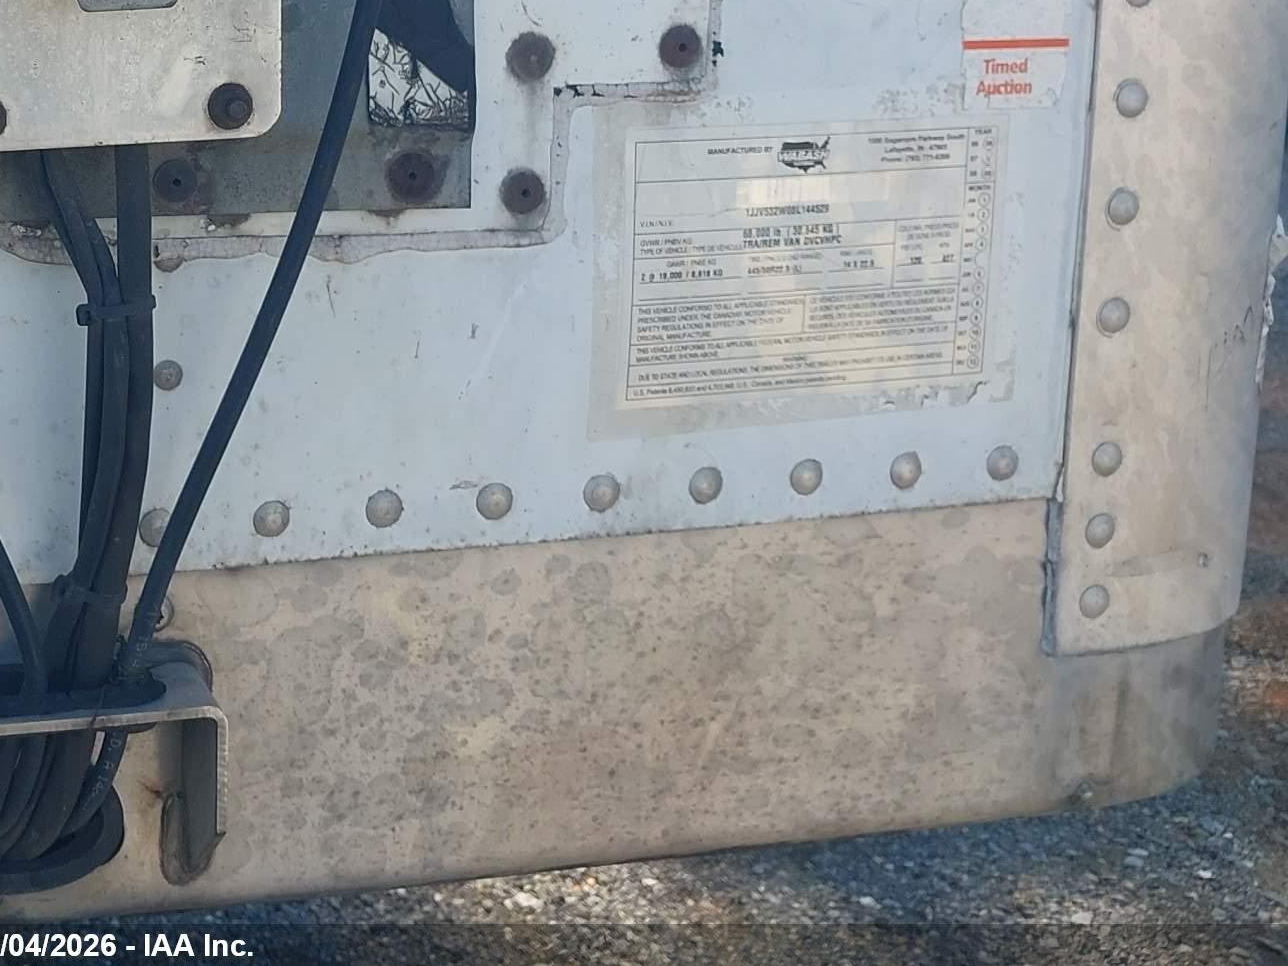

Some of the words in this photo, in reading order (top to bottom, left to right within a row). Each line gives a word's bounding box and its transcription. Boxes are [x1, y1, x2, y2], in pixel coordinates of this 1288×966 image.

[983, 58, 1028, 74] Timed
[976, 80, 1032, 95] Auction
[783, 237, 801, 247] VAN
